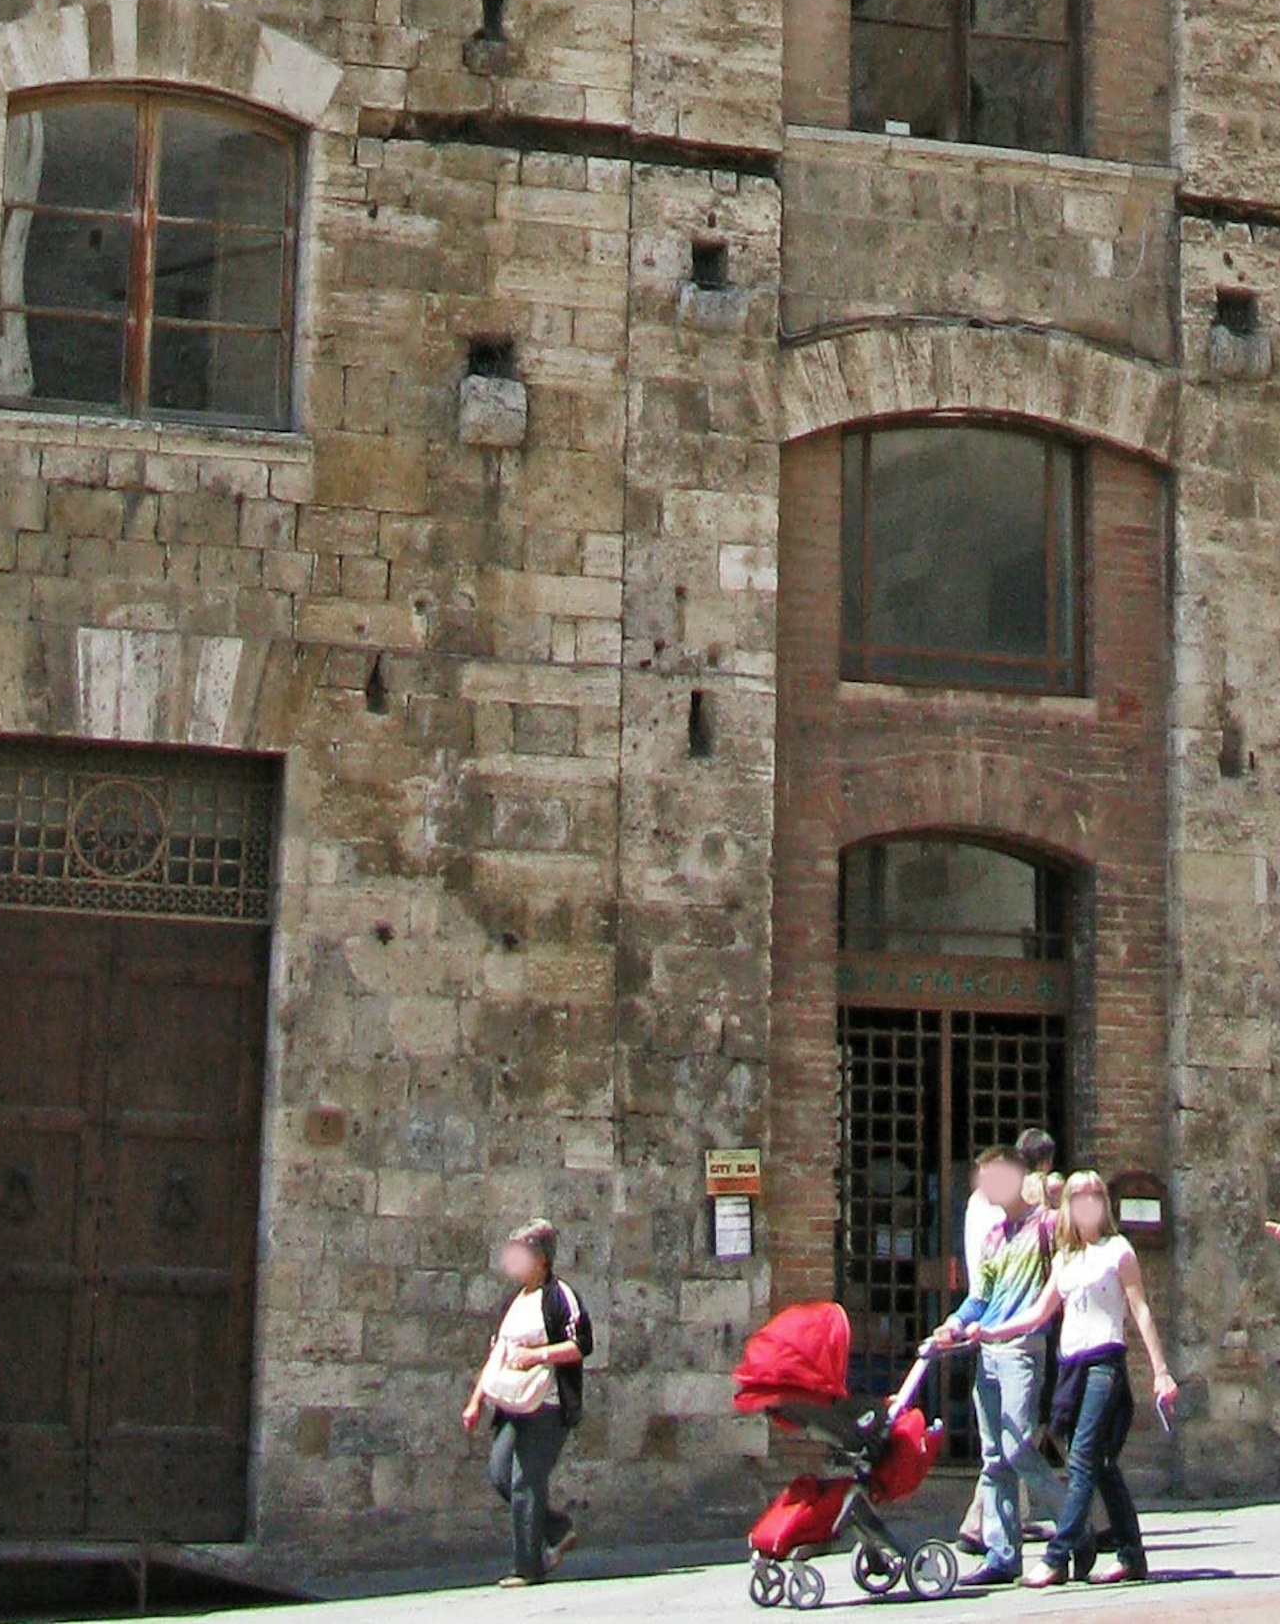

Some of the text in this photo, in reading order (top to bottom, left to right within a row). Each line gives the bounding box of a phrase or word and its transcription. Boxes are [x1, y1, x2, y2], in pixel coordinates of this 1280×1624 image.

[863, 967, 1026, 999] FARMACIA
[710, 1162, 756, 1174] CITY BUS
